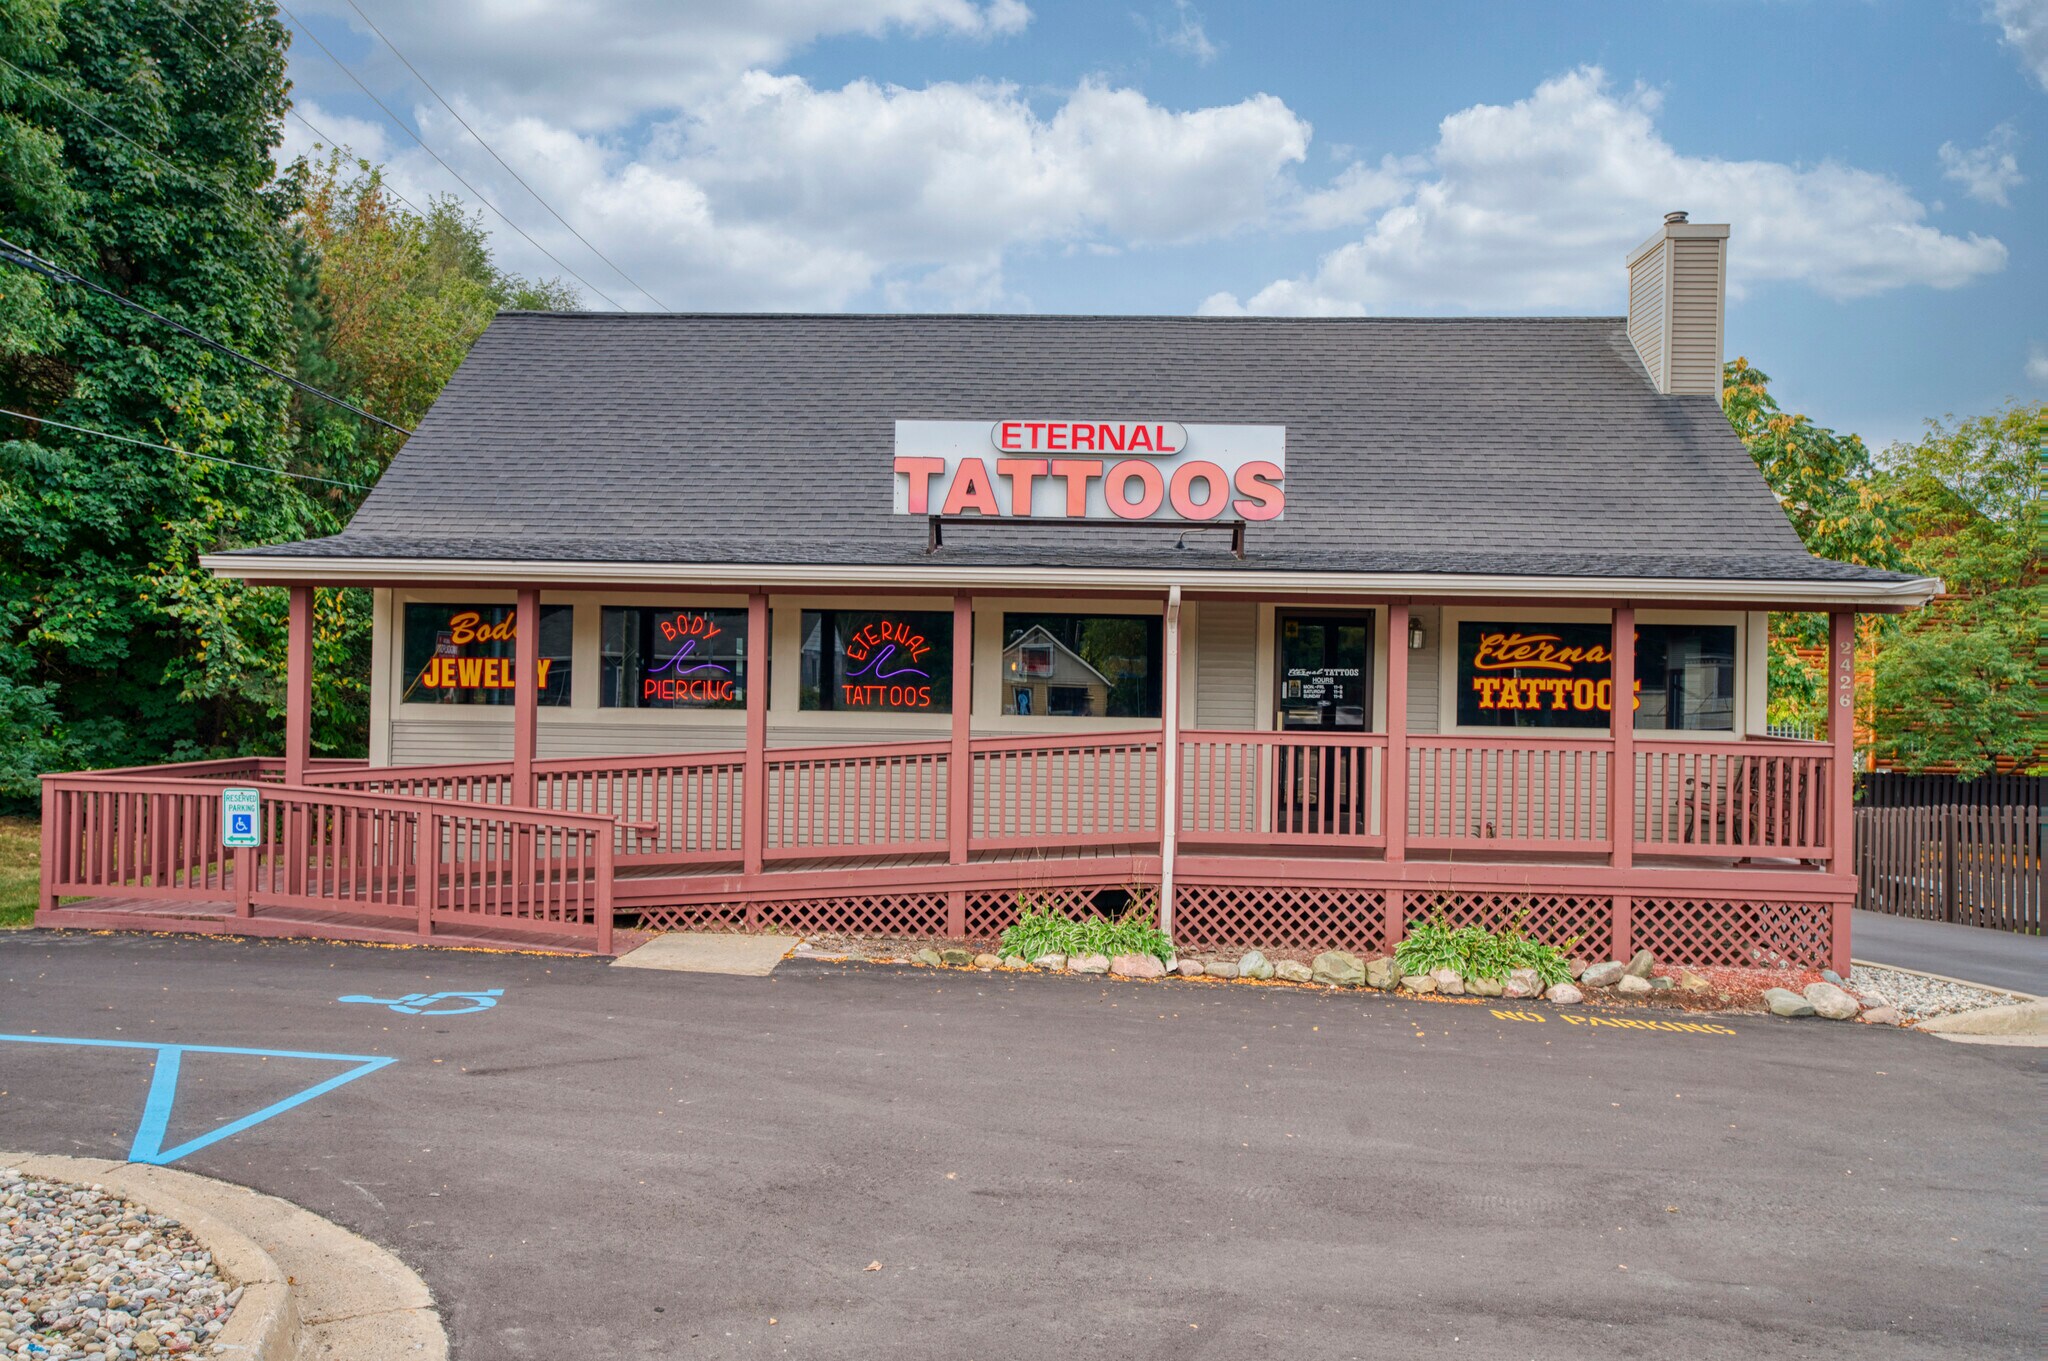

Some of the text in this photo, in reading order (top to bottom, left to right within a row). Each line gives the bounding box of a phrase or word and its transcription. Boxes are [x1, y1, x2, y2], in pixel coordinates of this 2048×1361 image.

[1001, 422, 1176, 452] ETERNAL
[894, 456, 1286, 522] TATTOOS
[449, 610, 518, 646] Bod
[660, 614, 721, 641] BODY
[847, 620, 931, 663] ETERNAL
[1473, 633, 1639, 671] Eterna
[422, 657, 551, 689] JEWELY
[1288, 668, 1359, 677] Eternal TATTOOS
[1840, 642, 1852, 707] 2426
[644, 679, 733, 701] PIERCING
[842, 685, 931, 707] TATTOOS
[1488, 1009, 1737, 1035] NO PARKING
